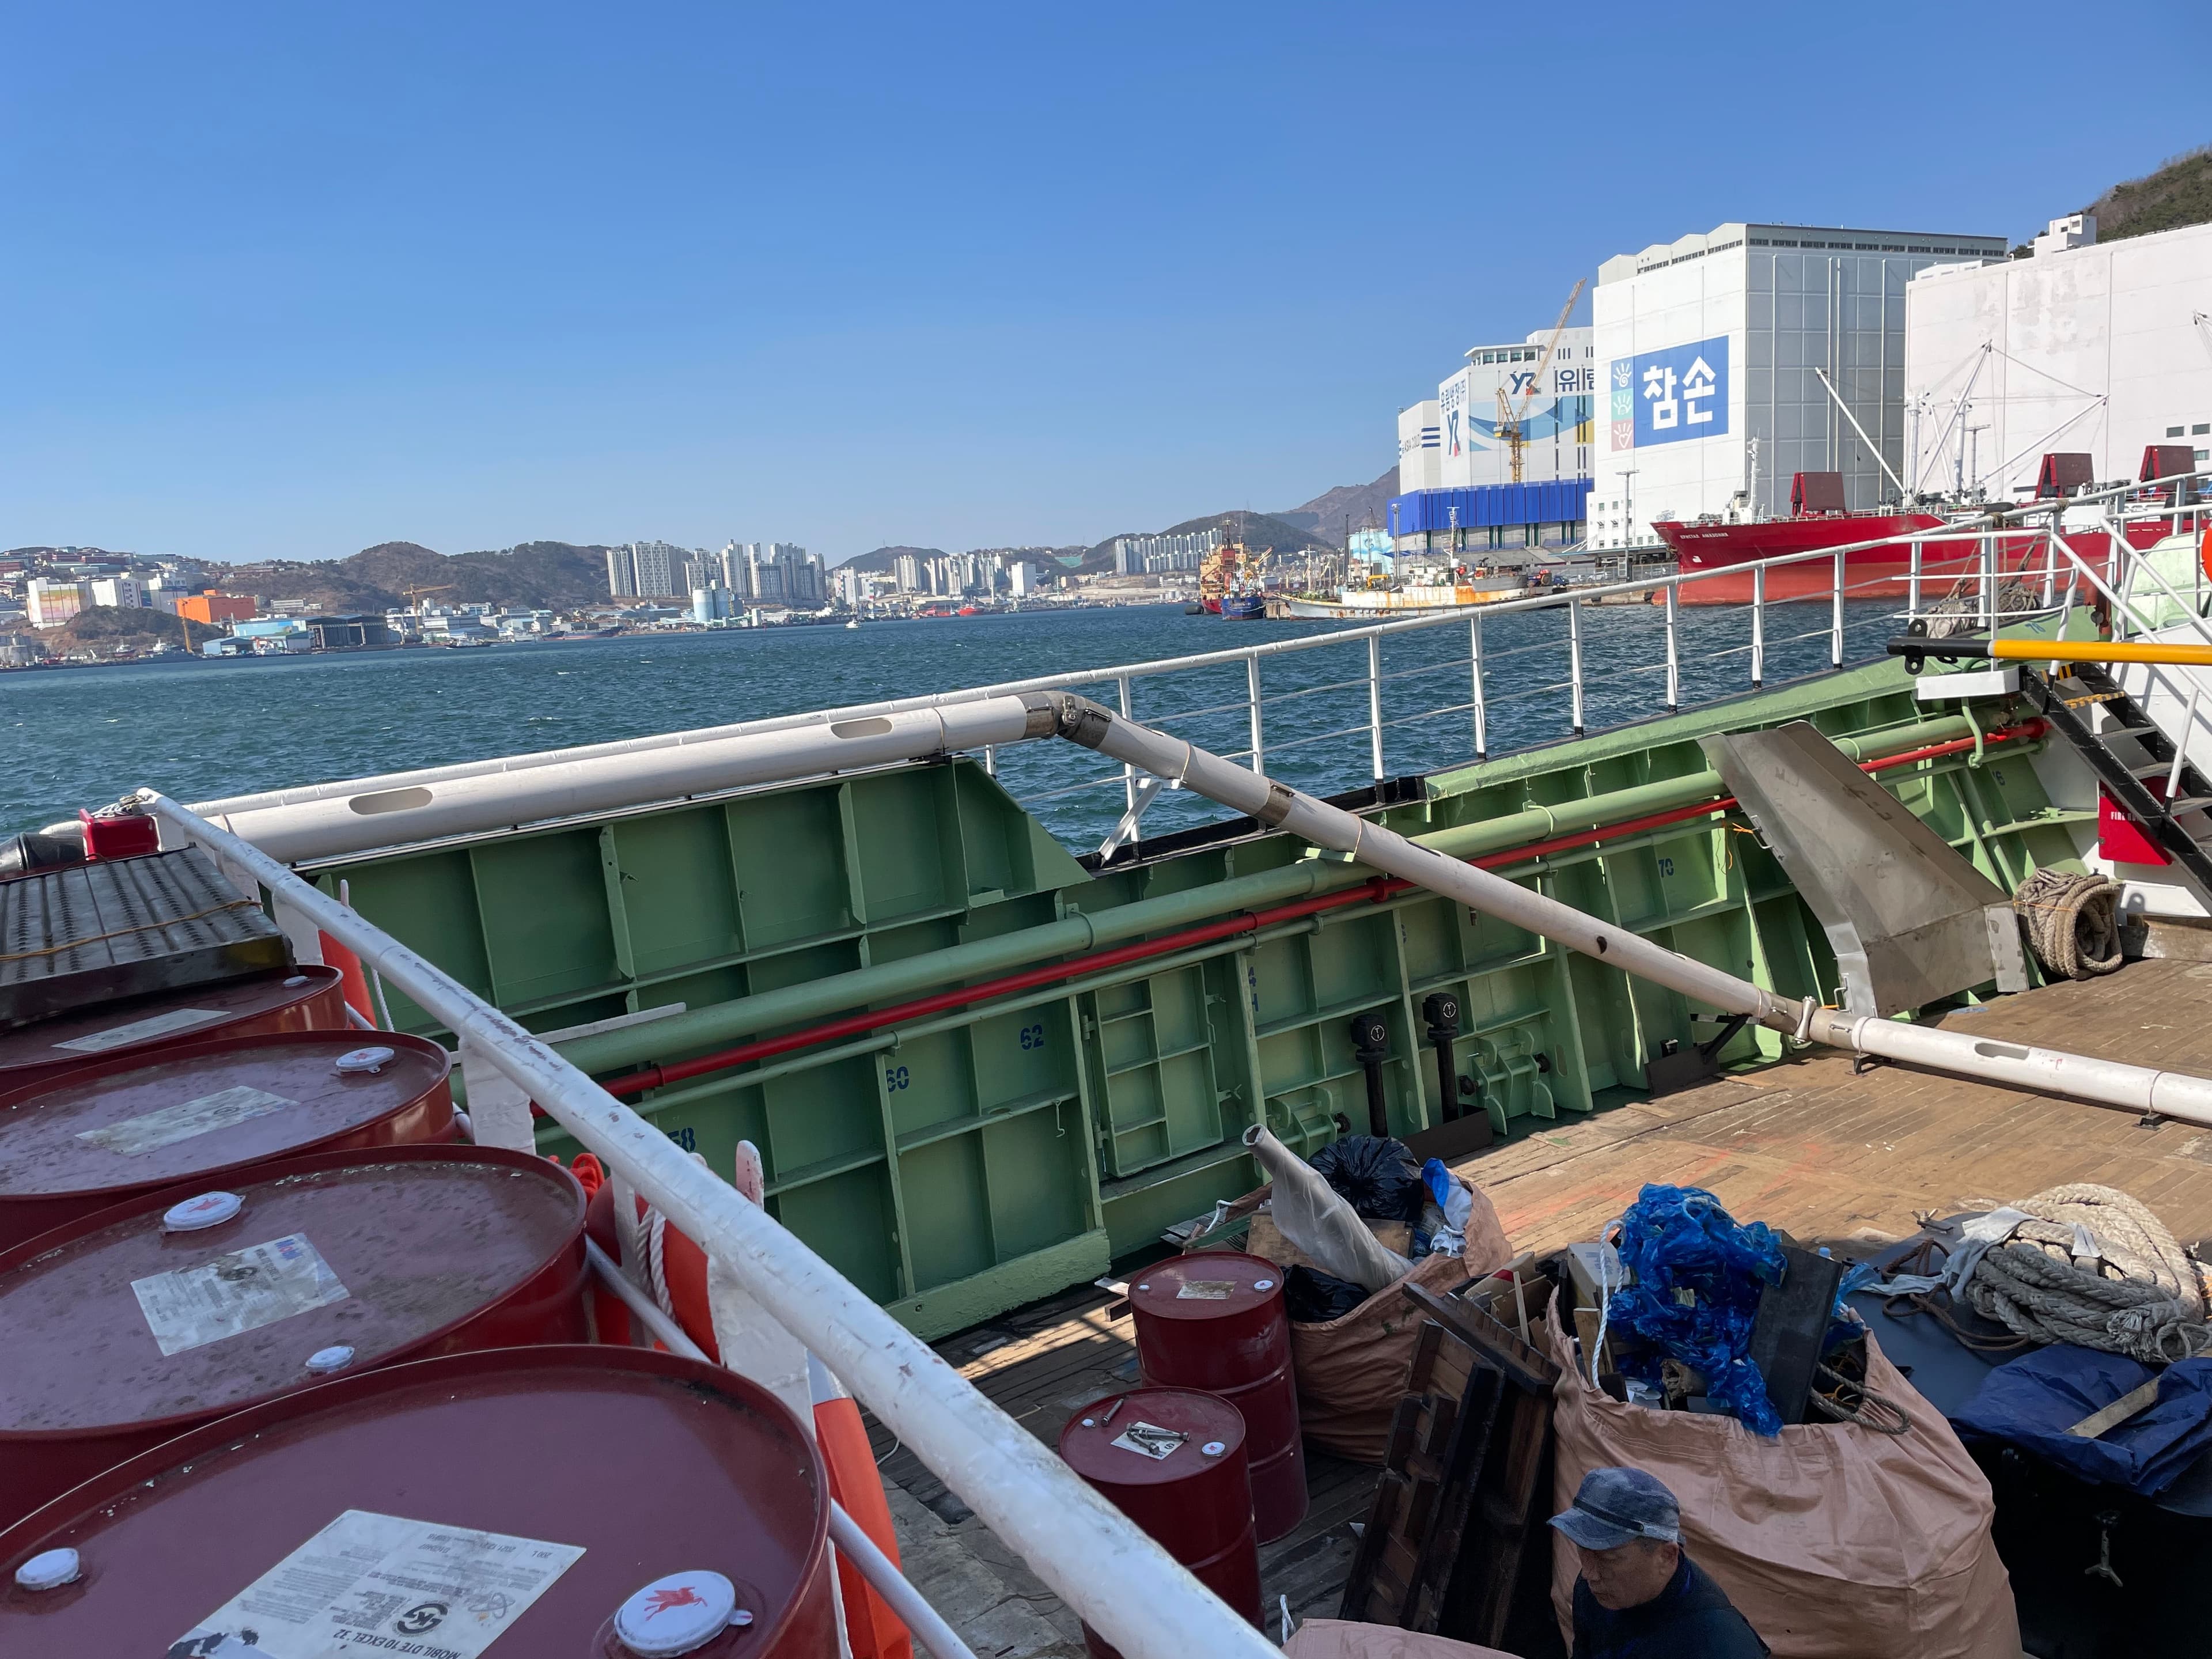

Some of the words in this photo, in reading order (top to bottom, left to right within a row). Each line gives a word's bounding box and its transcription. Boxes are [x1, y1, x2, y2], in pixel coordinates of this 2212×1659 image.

[1643, 355, 1716, 430] 참손
[2111, 811, 2126, 820] FIRE
[1658, 858, 1674, 878] 70
[1021, 1024, 1044, 1050] 62
[886, 1066, 909, 1092] 60
[352, 1632, 388, 1646] EXCEL
[399, 1642, 425, 1654] DTE
[423, 1646, 462, 1659] MOBIL
